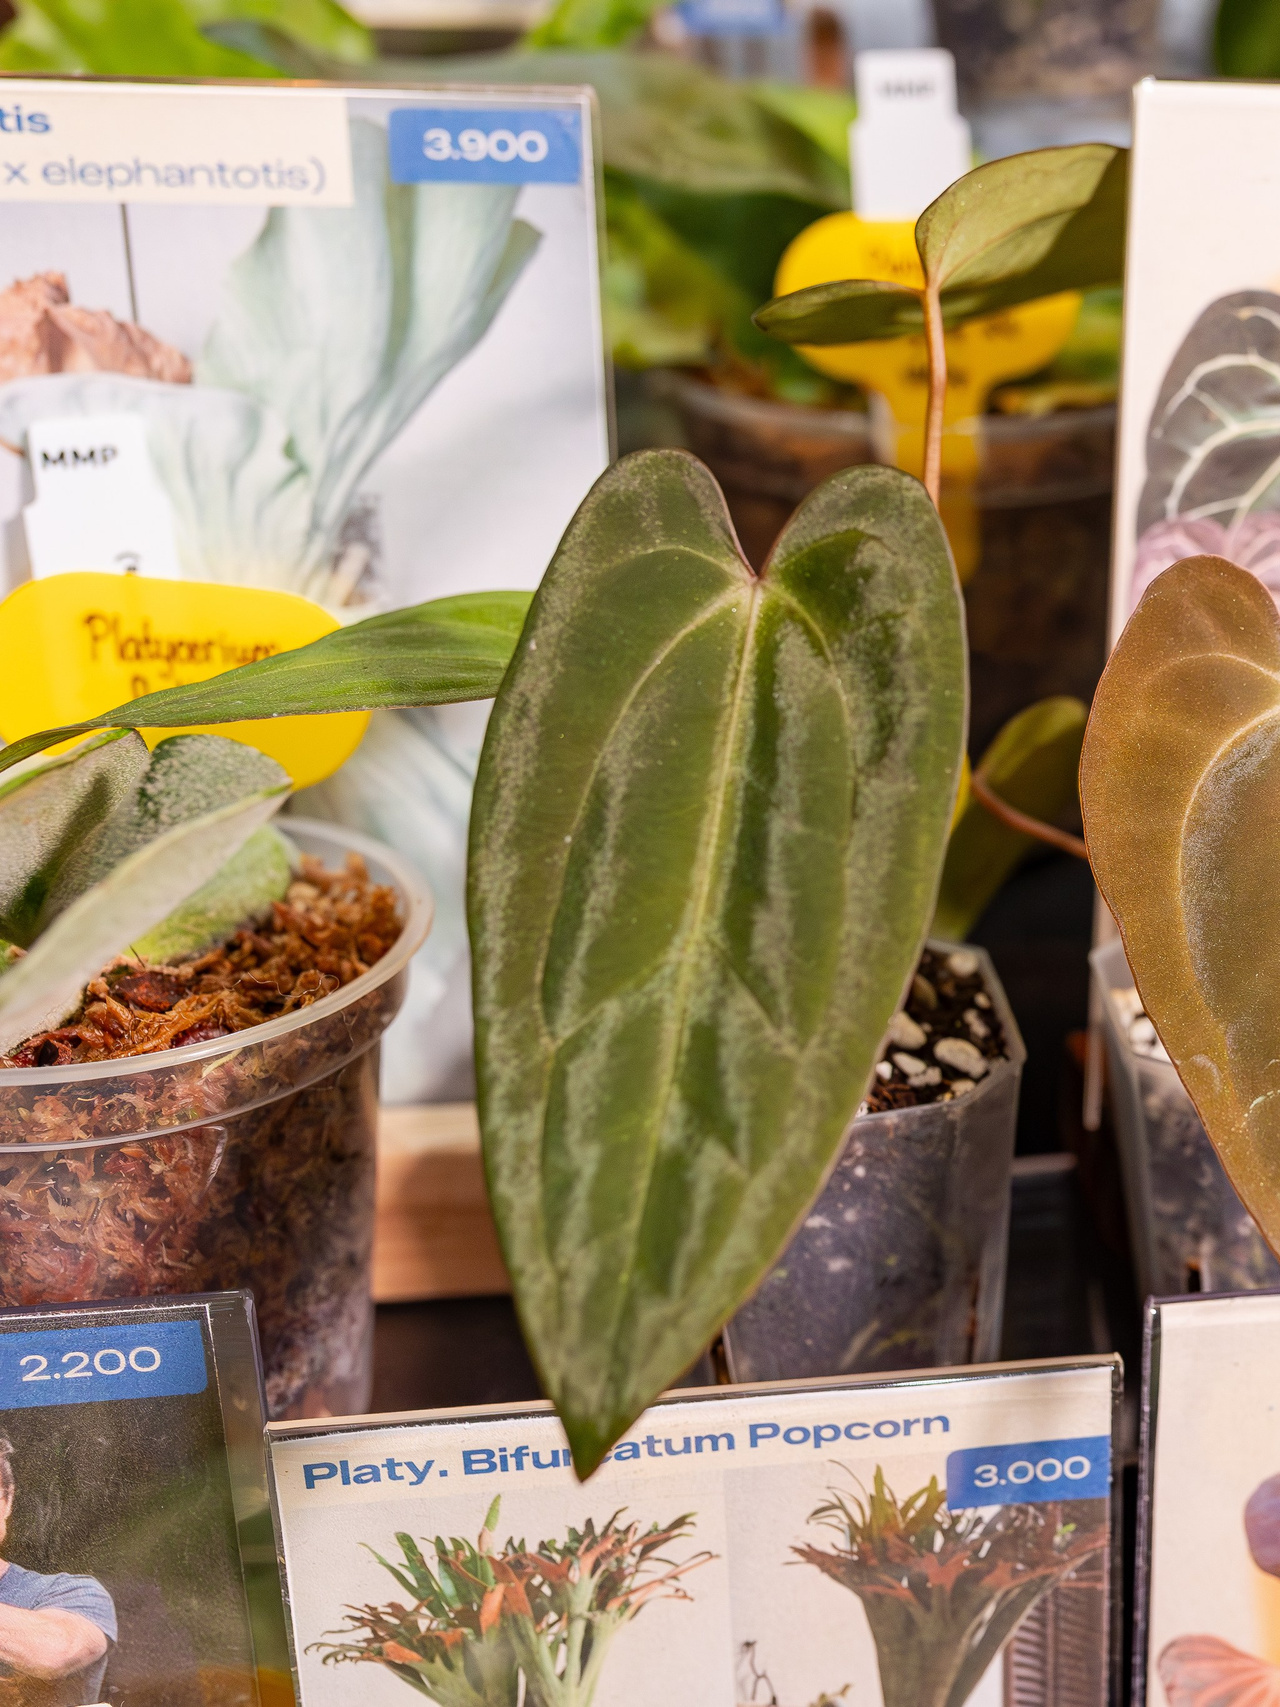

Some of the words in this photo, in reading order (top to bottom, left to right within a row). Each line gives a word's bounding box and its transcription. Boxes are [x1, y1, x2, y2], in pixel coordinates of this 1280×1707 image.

[422, 127, 549, 163] 3.900
[41, 155, 327, 196] elephantotis)
[41, 446, 118, 469] MMP
[19, 1344, 163, 1383] 2.200
[302, 1457, 449, 1490] Platy.
[462, 1431, 737, 1476] Bifuratum
[748, 1414, 951, 1450] Popcorn
[973, 1454, 1093, 1489] 3.000
